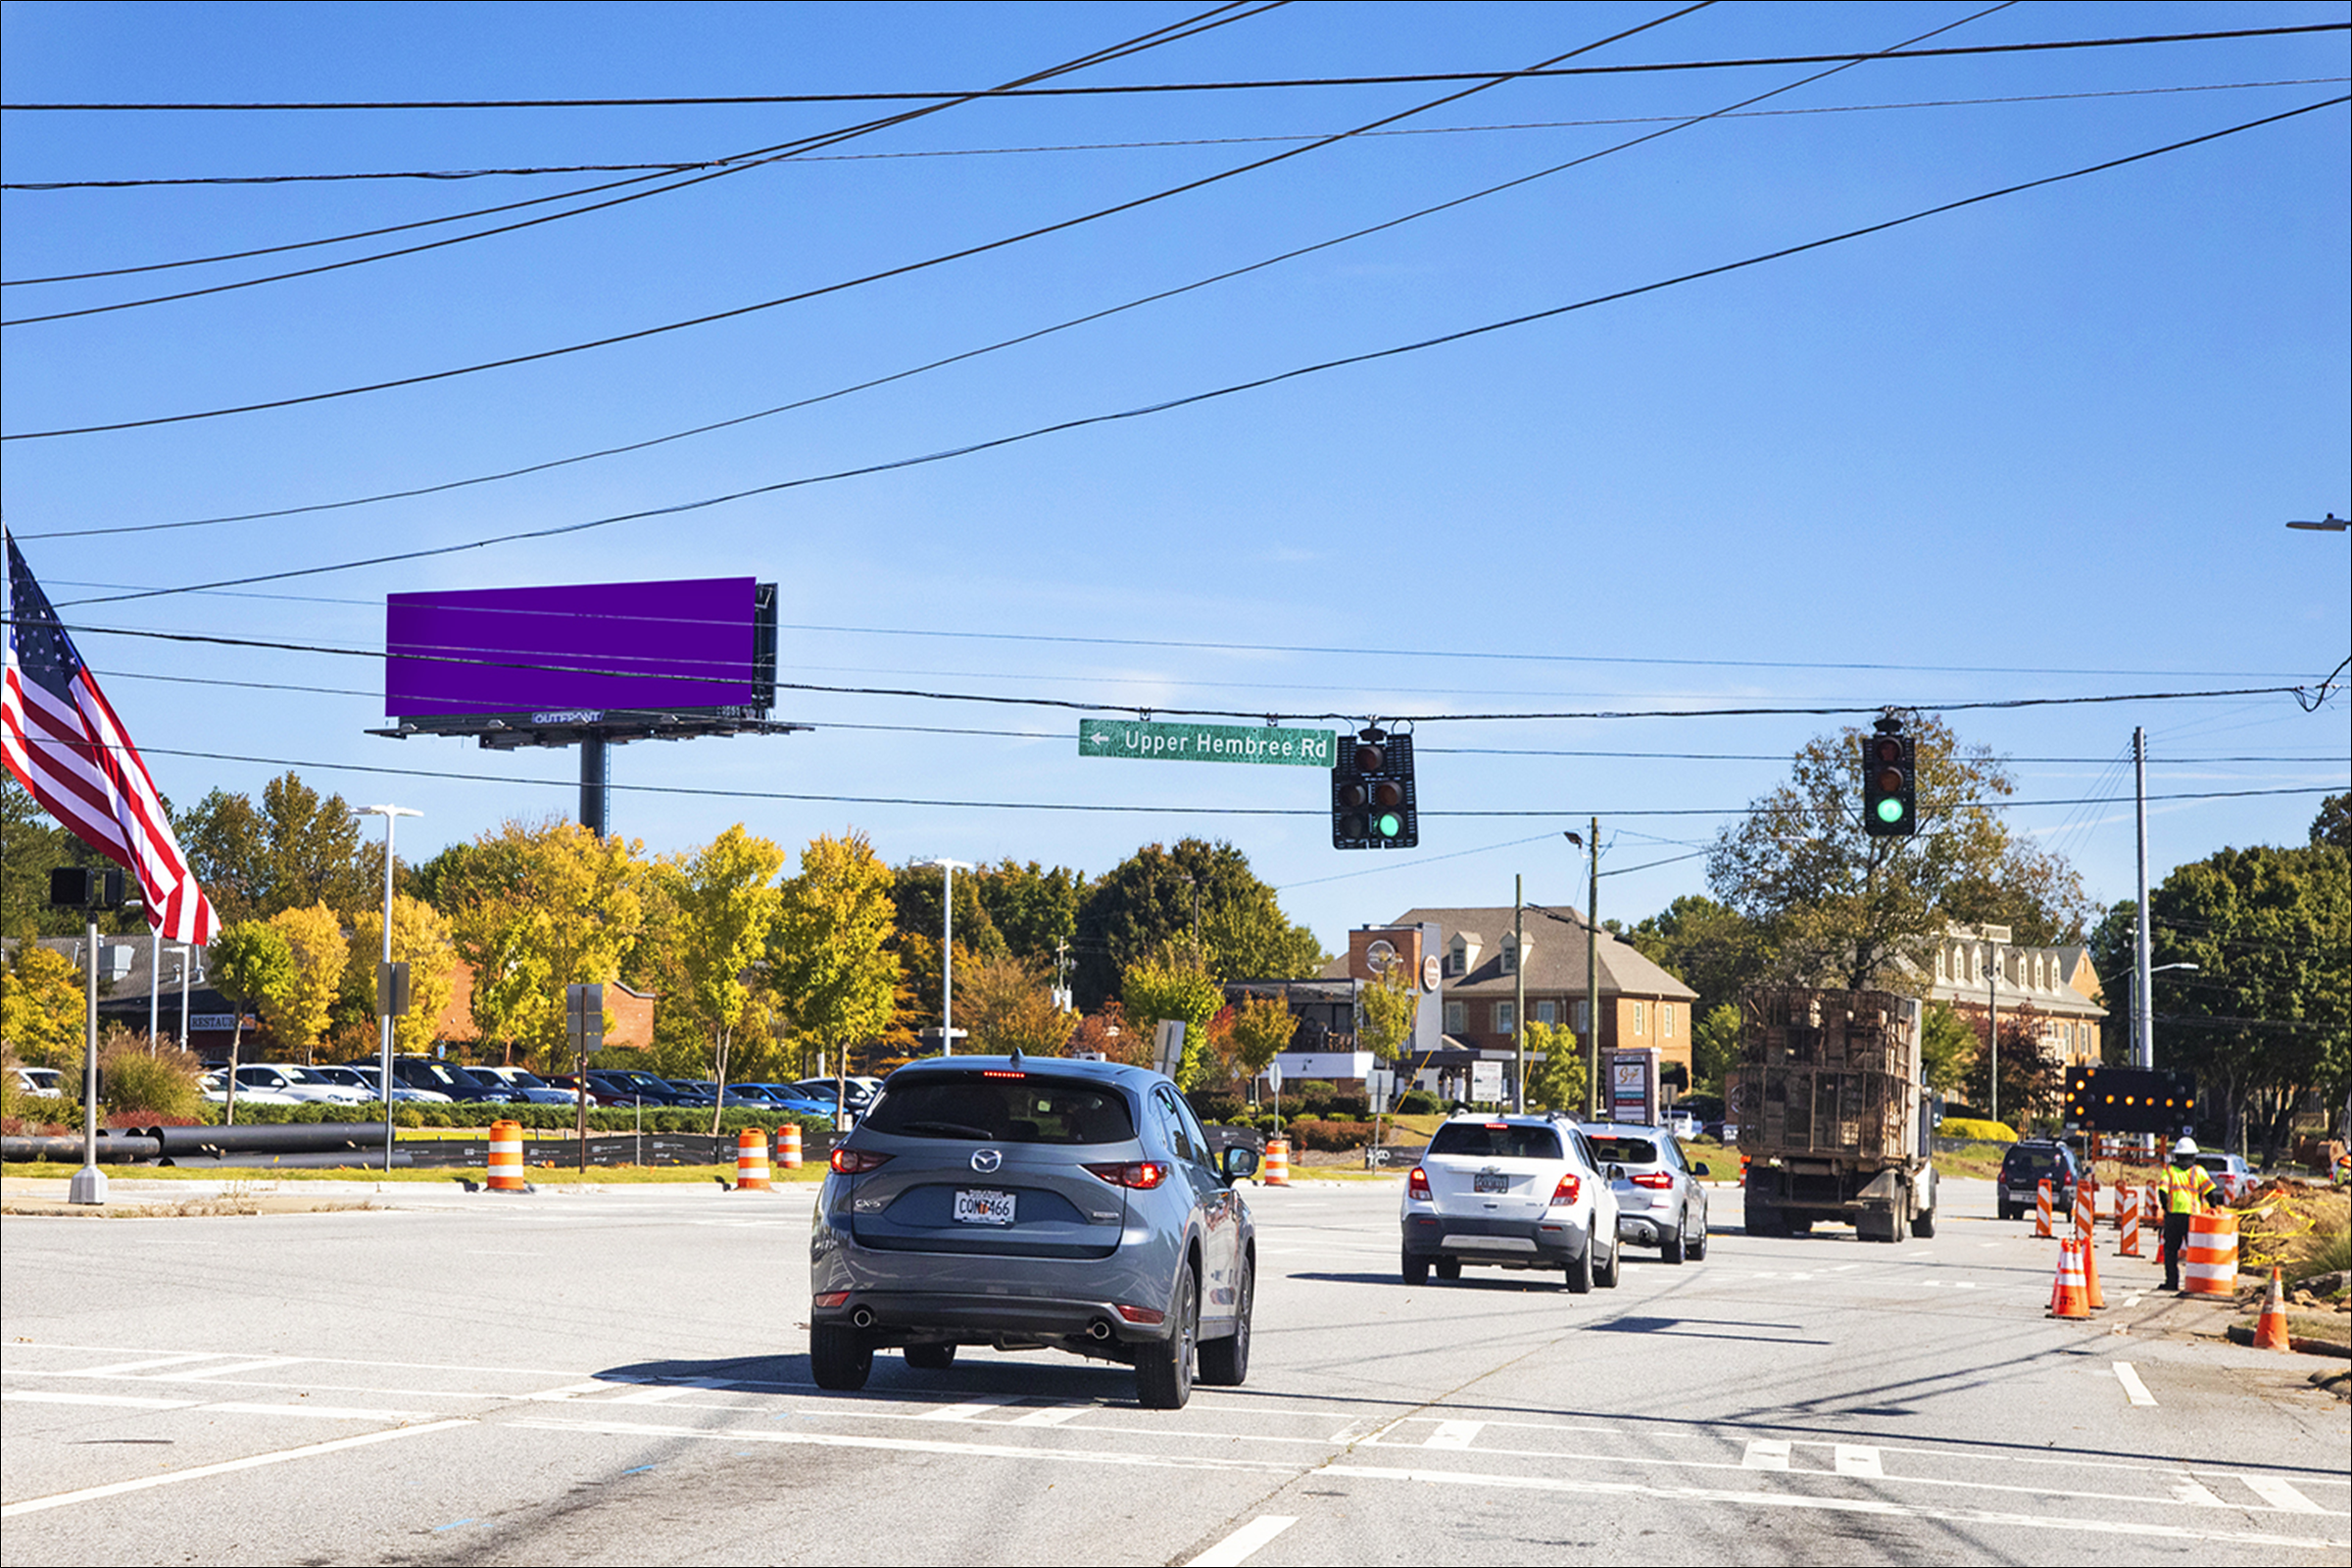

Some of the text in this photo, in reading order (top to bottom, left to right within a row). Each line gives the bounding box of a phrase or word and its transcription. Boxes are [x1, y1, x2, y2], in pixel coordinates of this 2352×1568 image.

[1126, 730, 1327, 758] Upper Hembree Rd
